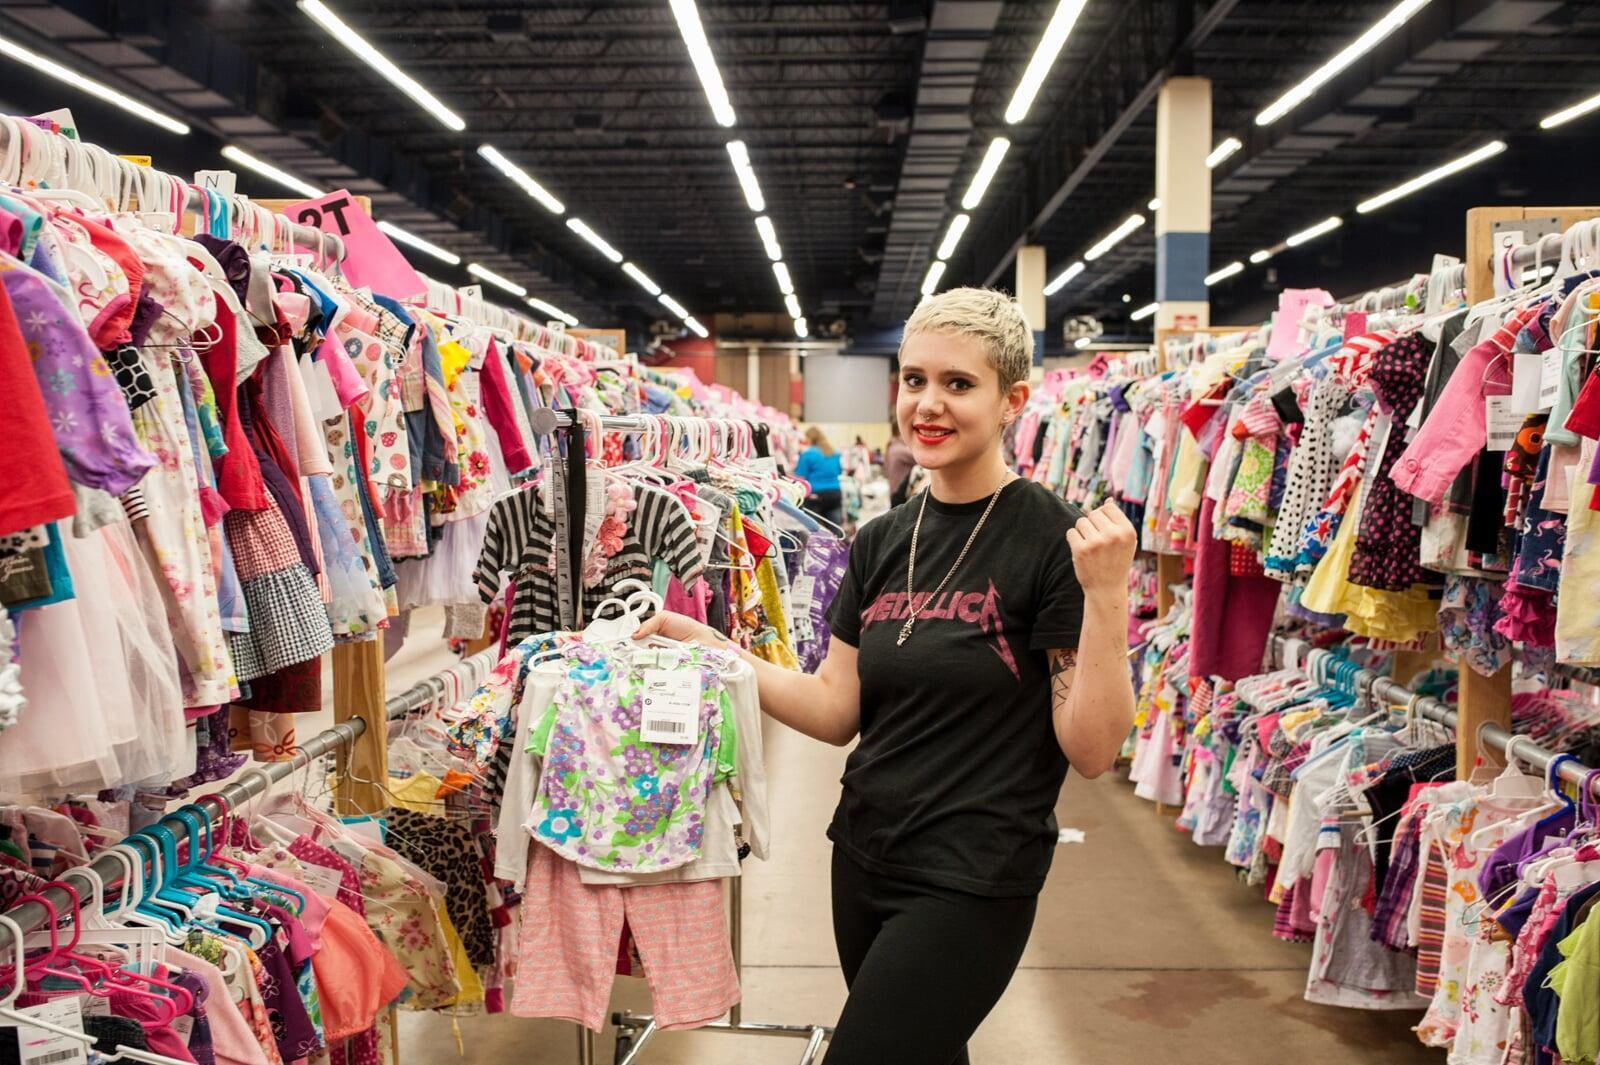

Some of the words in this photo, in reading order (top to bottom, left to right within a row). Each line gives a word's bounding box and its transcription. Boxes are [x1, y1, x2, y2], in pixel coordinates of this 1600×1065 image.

[206, 174, 219, 188] N
[298, 197, 351, 236] 2T
[1090, 355, 1109, 376] 3T
